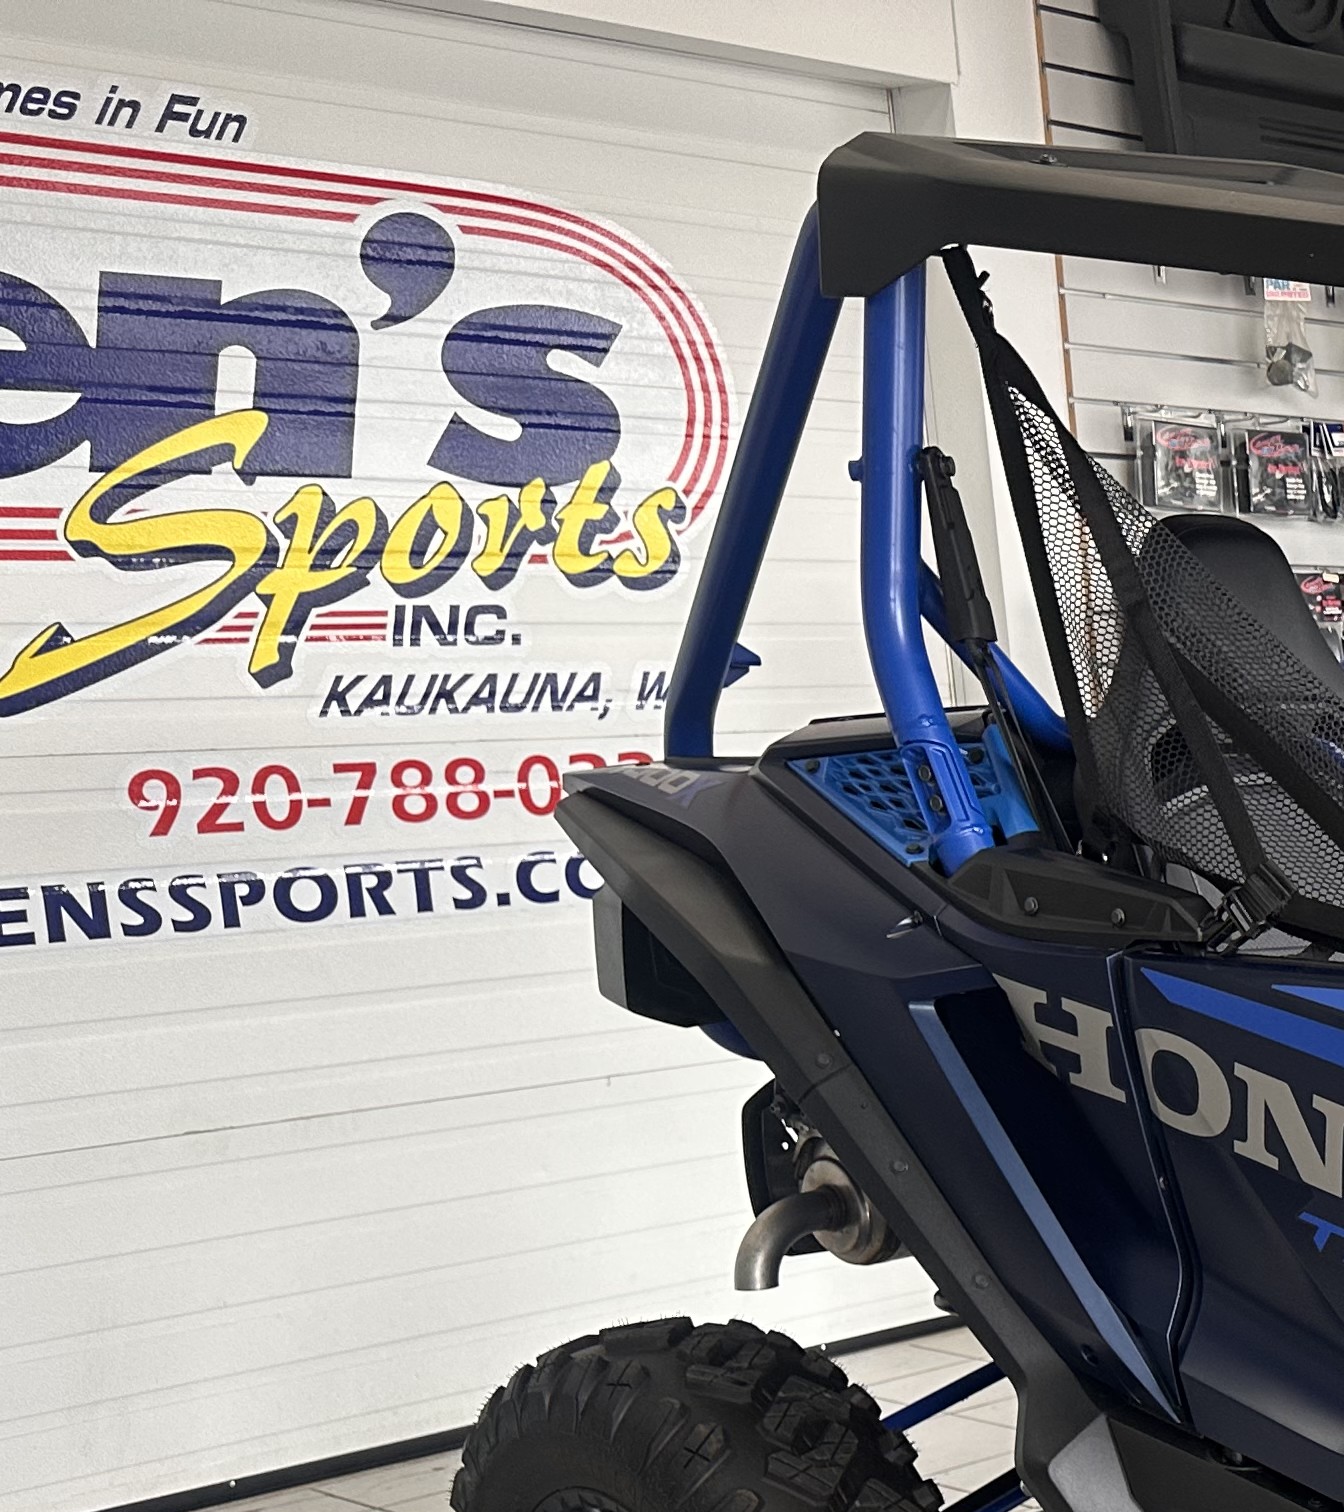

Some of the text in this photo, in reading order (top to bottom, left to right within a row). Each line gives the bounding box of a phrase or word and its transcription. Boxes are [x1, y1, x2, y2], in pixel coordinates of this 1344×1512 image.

[94, 85, 142, 129] in
[154, 93, 248, 144] Fun
[0, 409, 687, 717] Sports
[392, 604, 521, 647] INC.
[319, 671, 669, 721] KAUKAUNA, W
[127, 752, 654, 838] 920-788-0
[0, 850, 606, 948] ENSSPORTS.CO
